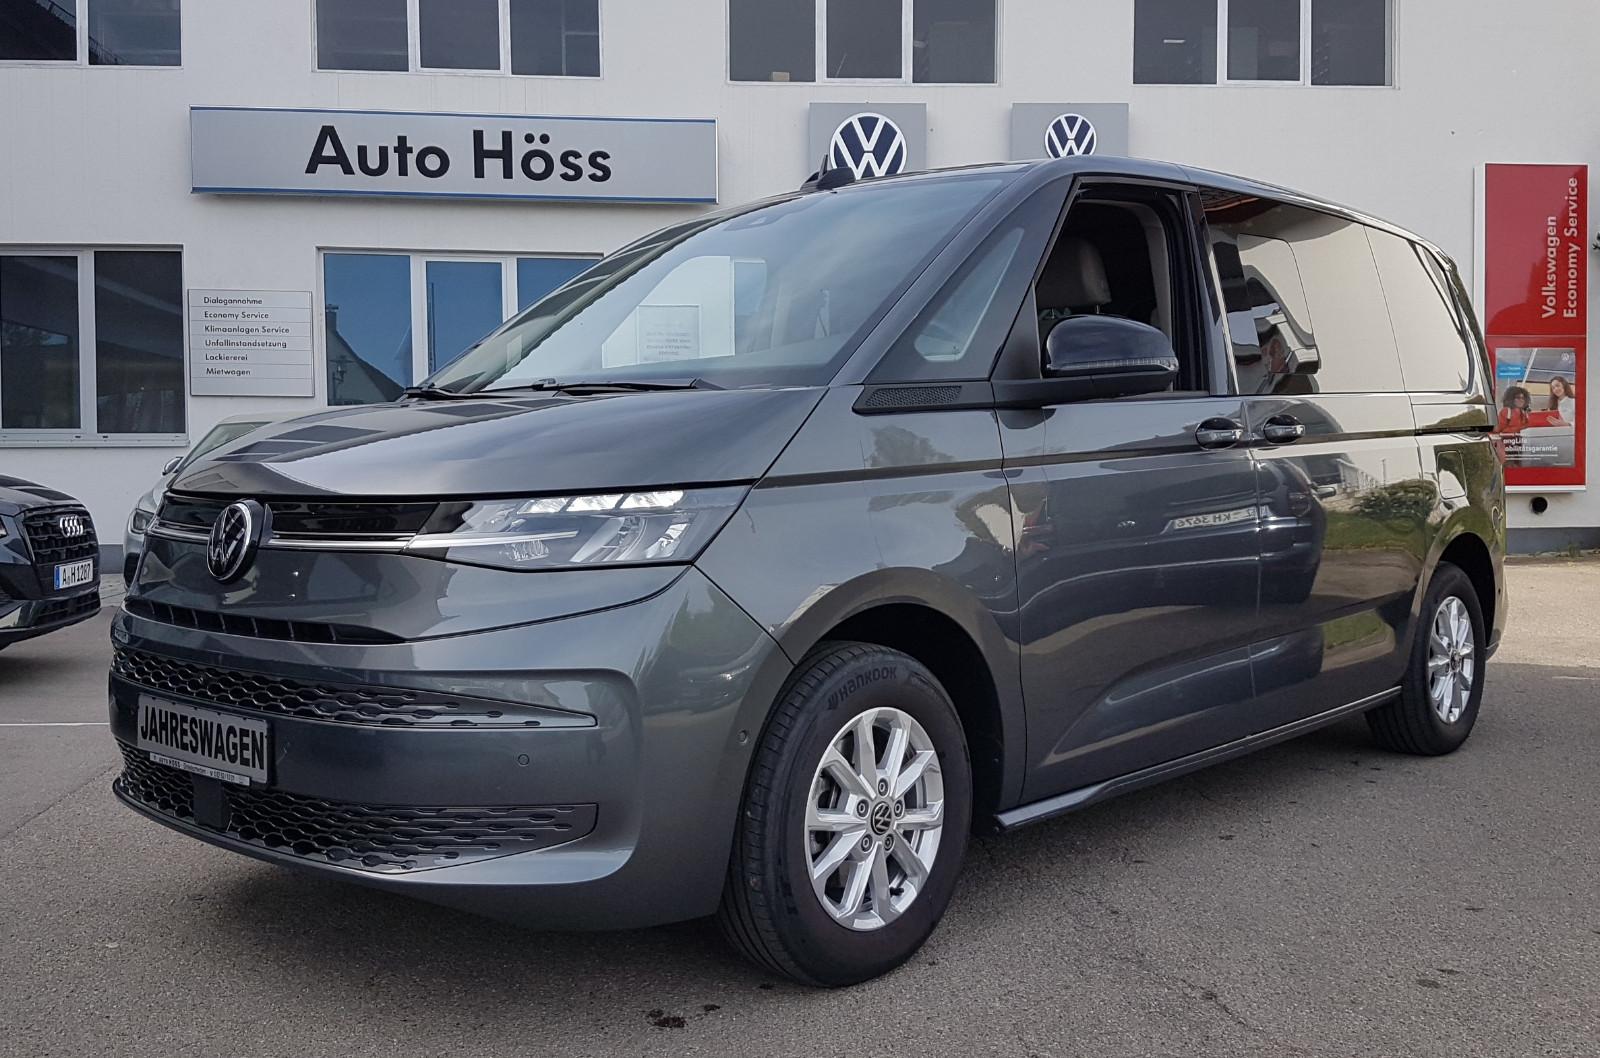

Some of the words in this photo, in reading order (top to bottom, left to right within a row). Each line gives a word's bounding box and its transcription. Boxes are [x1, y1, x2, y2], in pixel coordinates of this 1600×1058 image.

[304, 125, 450, 178] Auto
[472, 130, 613, 183] Höss
[1564, 177, 1578, 237] Service
[1541, 216, 1560, 318] Volkswagen
[1563, 243, 1581, 318] Economy
[203, 297, 263, 306] Dialogannahme
[204, 311, 240, 320] Economy
[241, 311, 269, 319] Service
[204, 325, 260, 335] Klimaanlagen
[205, 339, 287, 349] Unfallinstandsetzung
[205, 353, 248, 361] Lackiererei
[206, 367, 251, 377] Mietwagen
[1502, 437, 1528, 445] ongLife
[140, 705, 265, 770] JAHRESWAGEN
